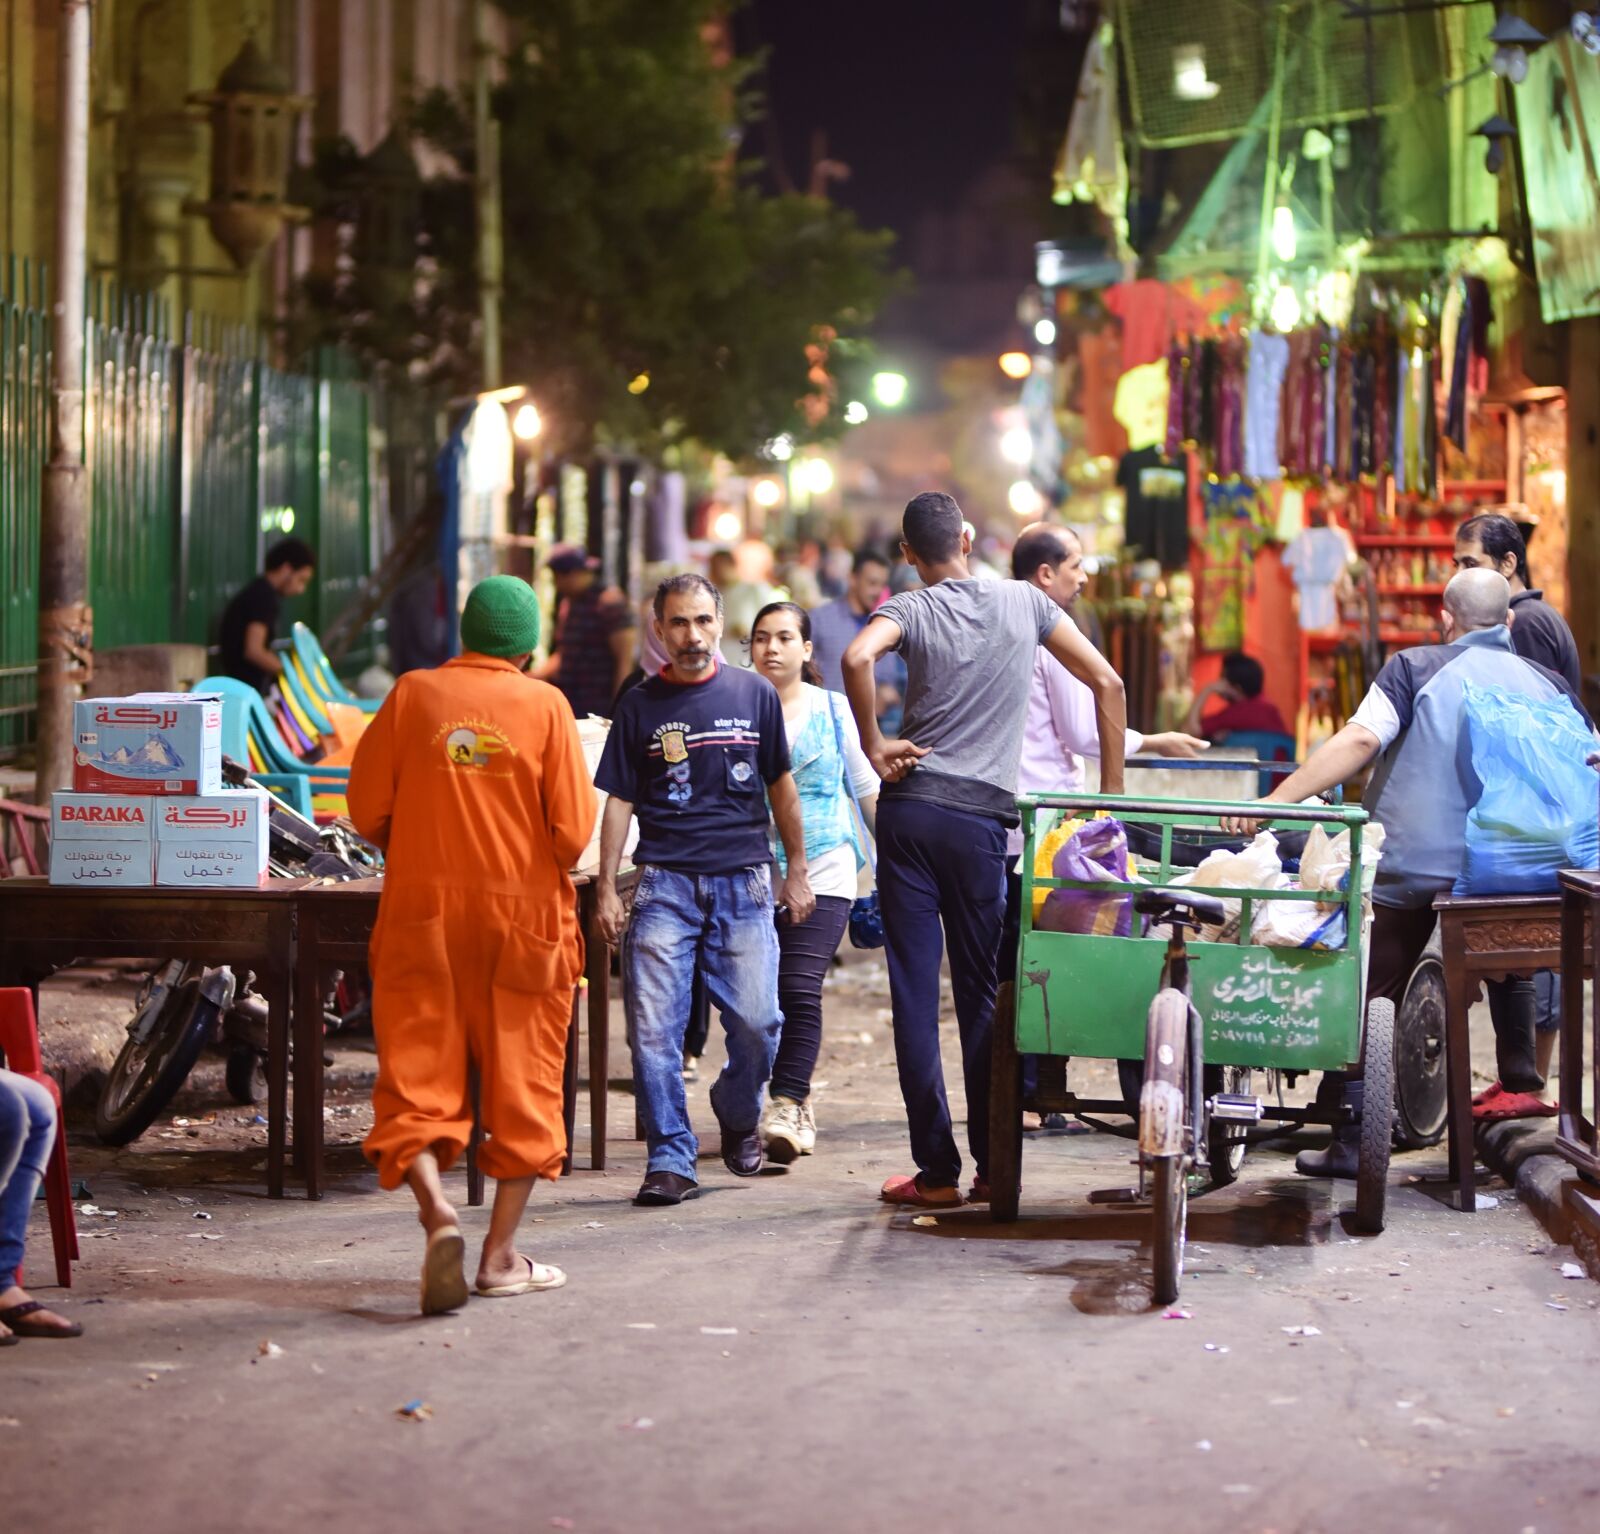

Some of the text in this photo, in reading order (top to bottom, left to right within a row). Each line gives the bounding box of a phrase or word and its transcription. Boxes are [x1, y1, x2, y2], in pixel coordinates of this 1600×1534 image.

[95, 706, 178, 730] بركة
[733, 717, 752, 729] boy
[652, 721, 691, 740] TOPBOYS
[667, 782, 692, 801] 23
[60, 805, 145, 823] BARAKA
[165, 806, 248, 829] بركة
